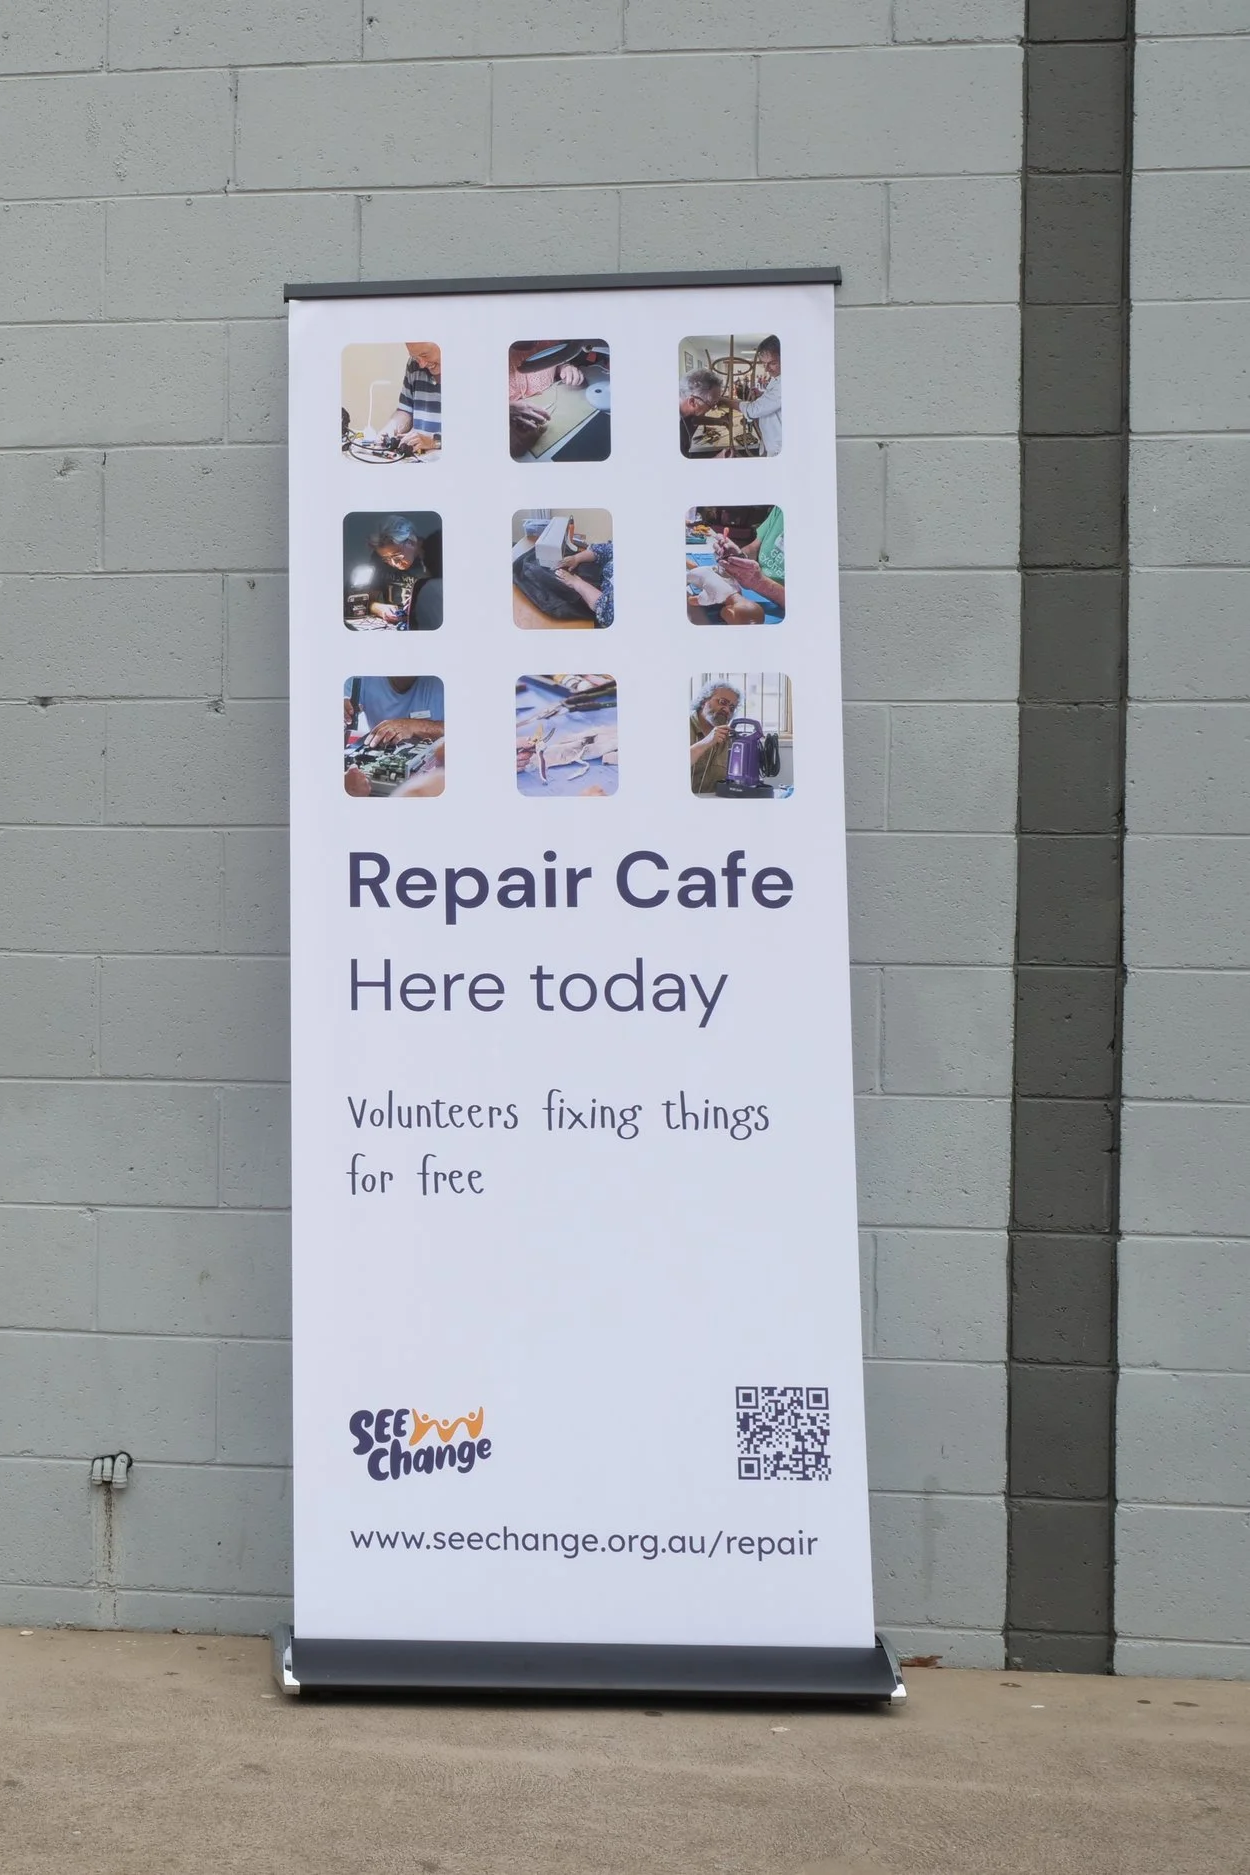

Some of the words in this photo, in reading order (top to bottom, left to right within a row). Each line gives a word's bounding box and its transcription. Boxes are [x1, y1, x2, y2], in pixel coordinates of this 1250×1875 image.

[349, 850, 593, 926] Repair
[615, 849, 794, 910] Cafe
[350, 958, 506, 1013] Here
[529, 957, 729, 1029] today
[347, 1089, 519, 1130] Volunteers
[541, 1088, 643, 1140] fixing
[661, 1090, 770, 1141] things
[346, 1153, 394, 1196] for
[416, 1153, 485, 1196] free
[349, 1408, 410, 1455] SEE
[350, 1525, 819, 1562] www.seechange.org.au/repair
